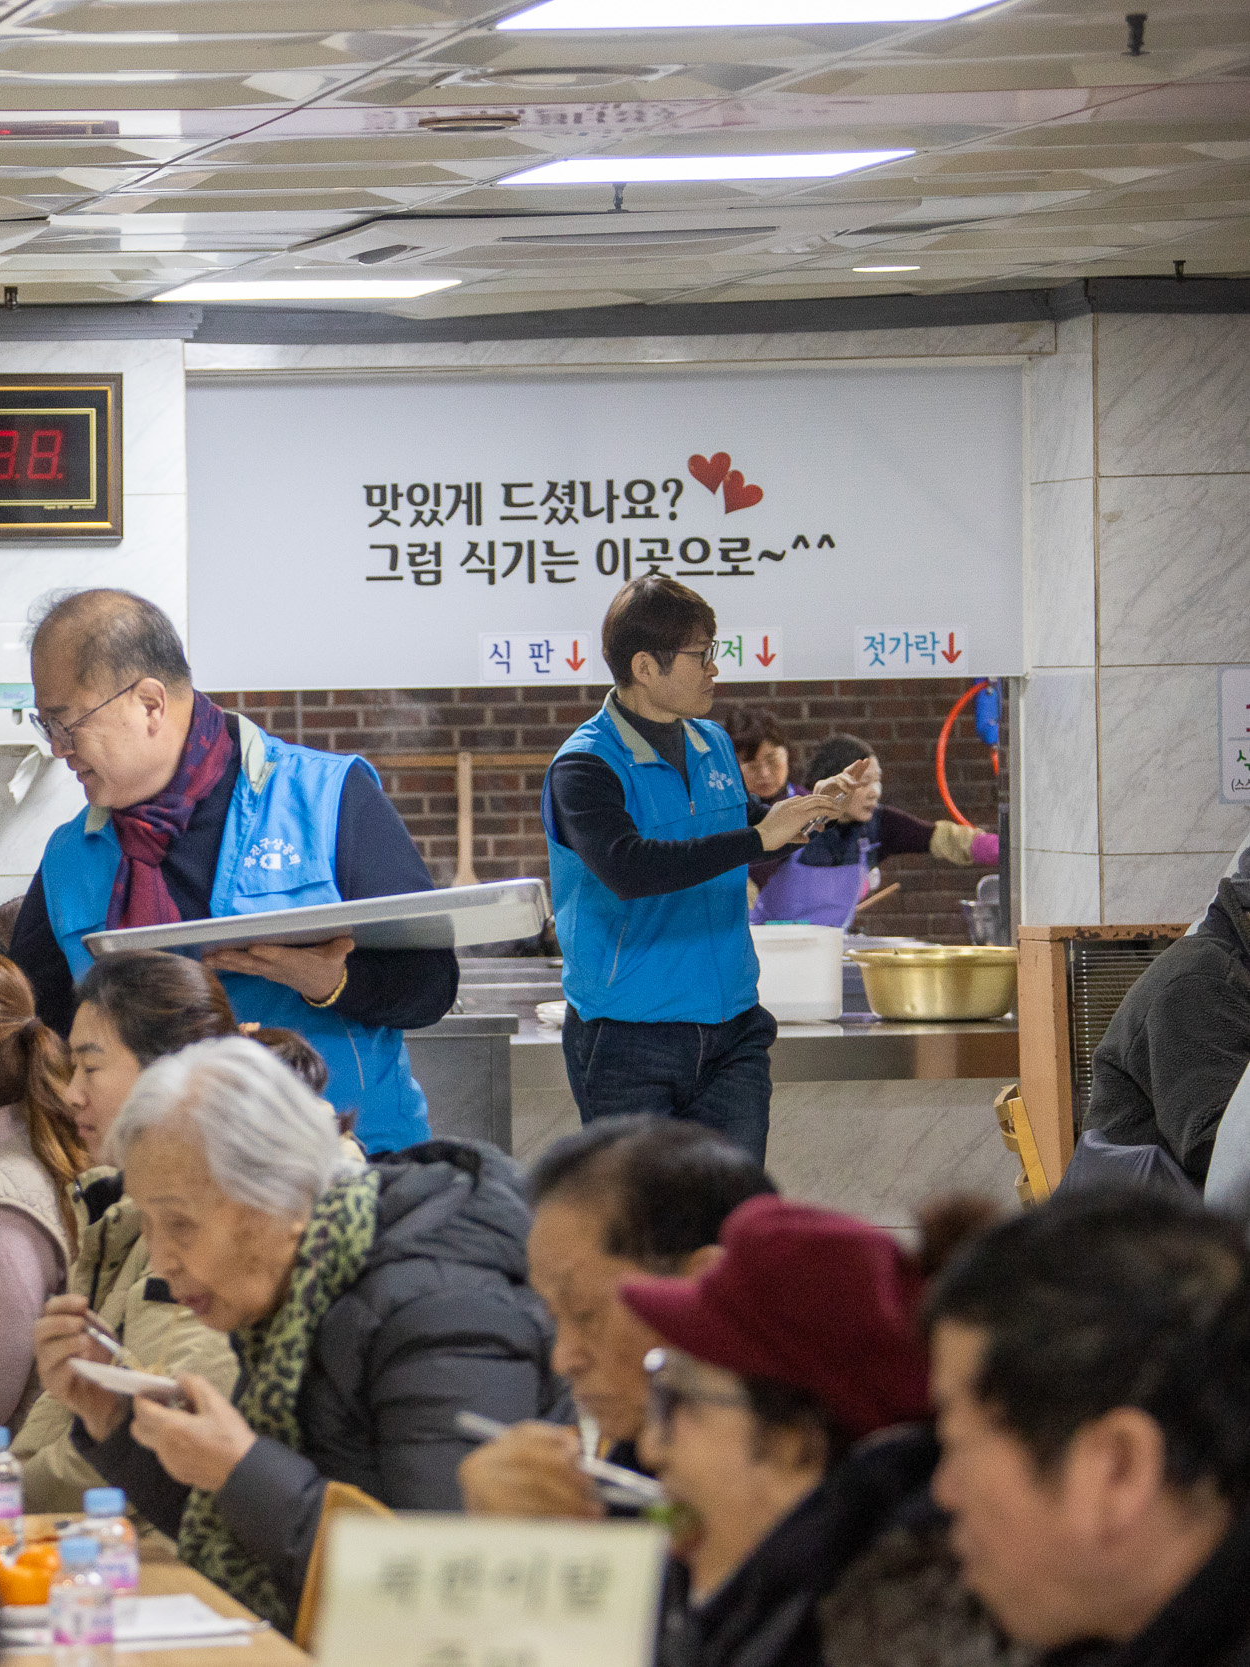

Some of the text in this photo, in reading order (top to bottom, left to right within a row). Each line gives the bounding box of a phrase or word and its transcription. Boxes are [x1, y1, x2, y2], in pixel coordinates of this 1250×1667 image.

[362, 478, 684, 528] 맛있게 드셨나요?
[365, 541, 442, 586] 그럼
[459, 539, 579, 585] 식기는
[863, 631, 940, 667] 젓가락
